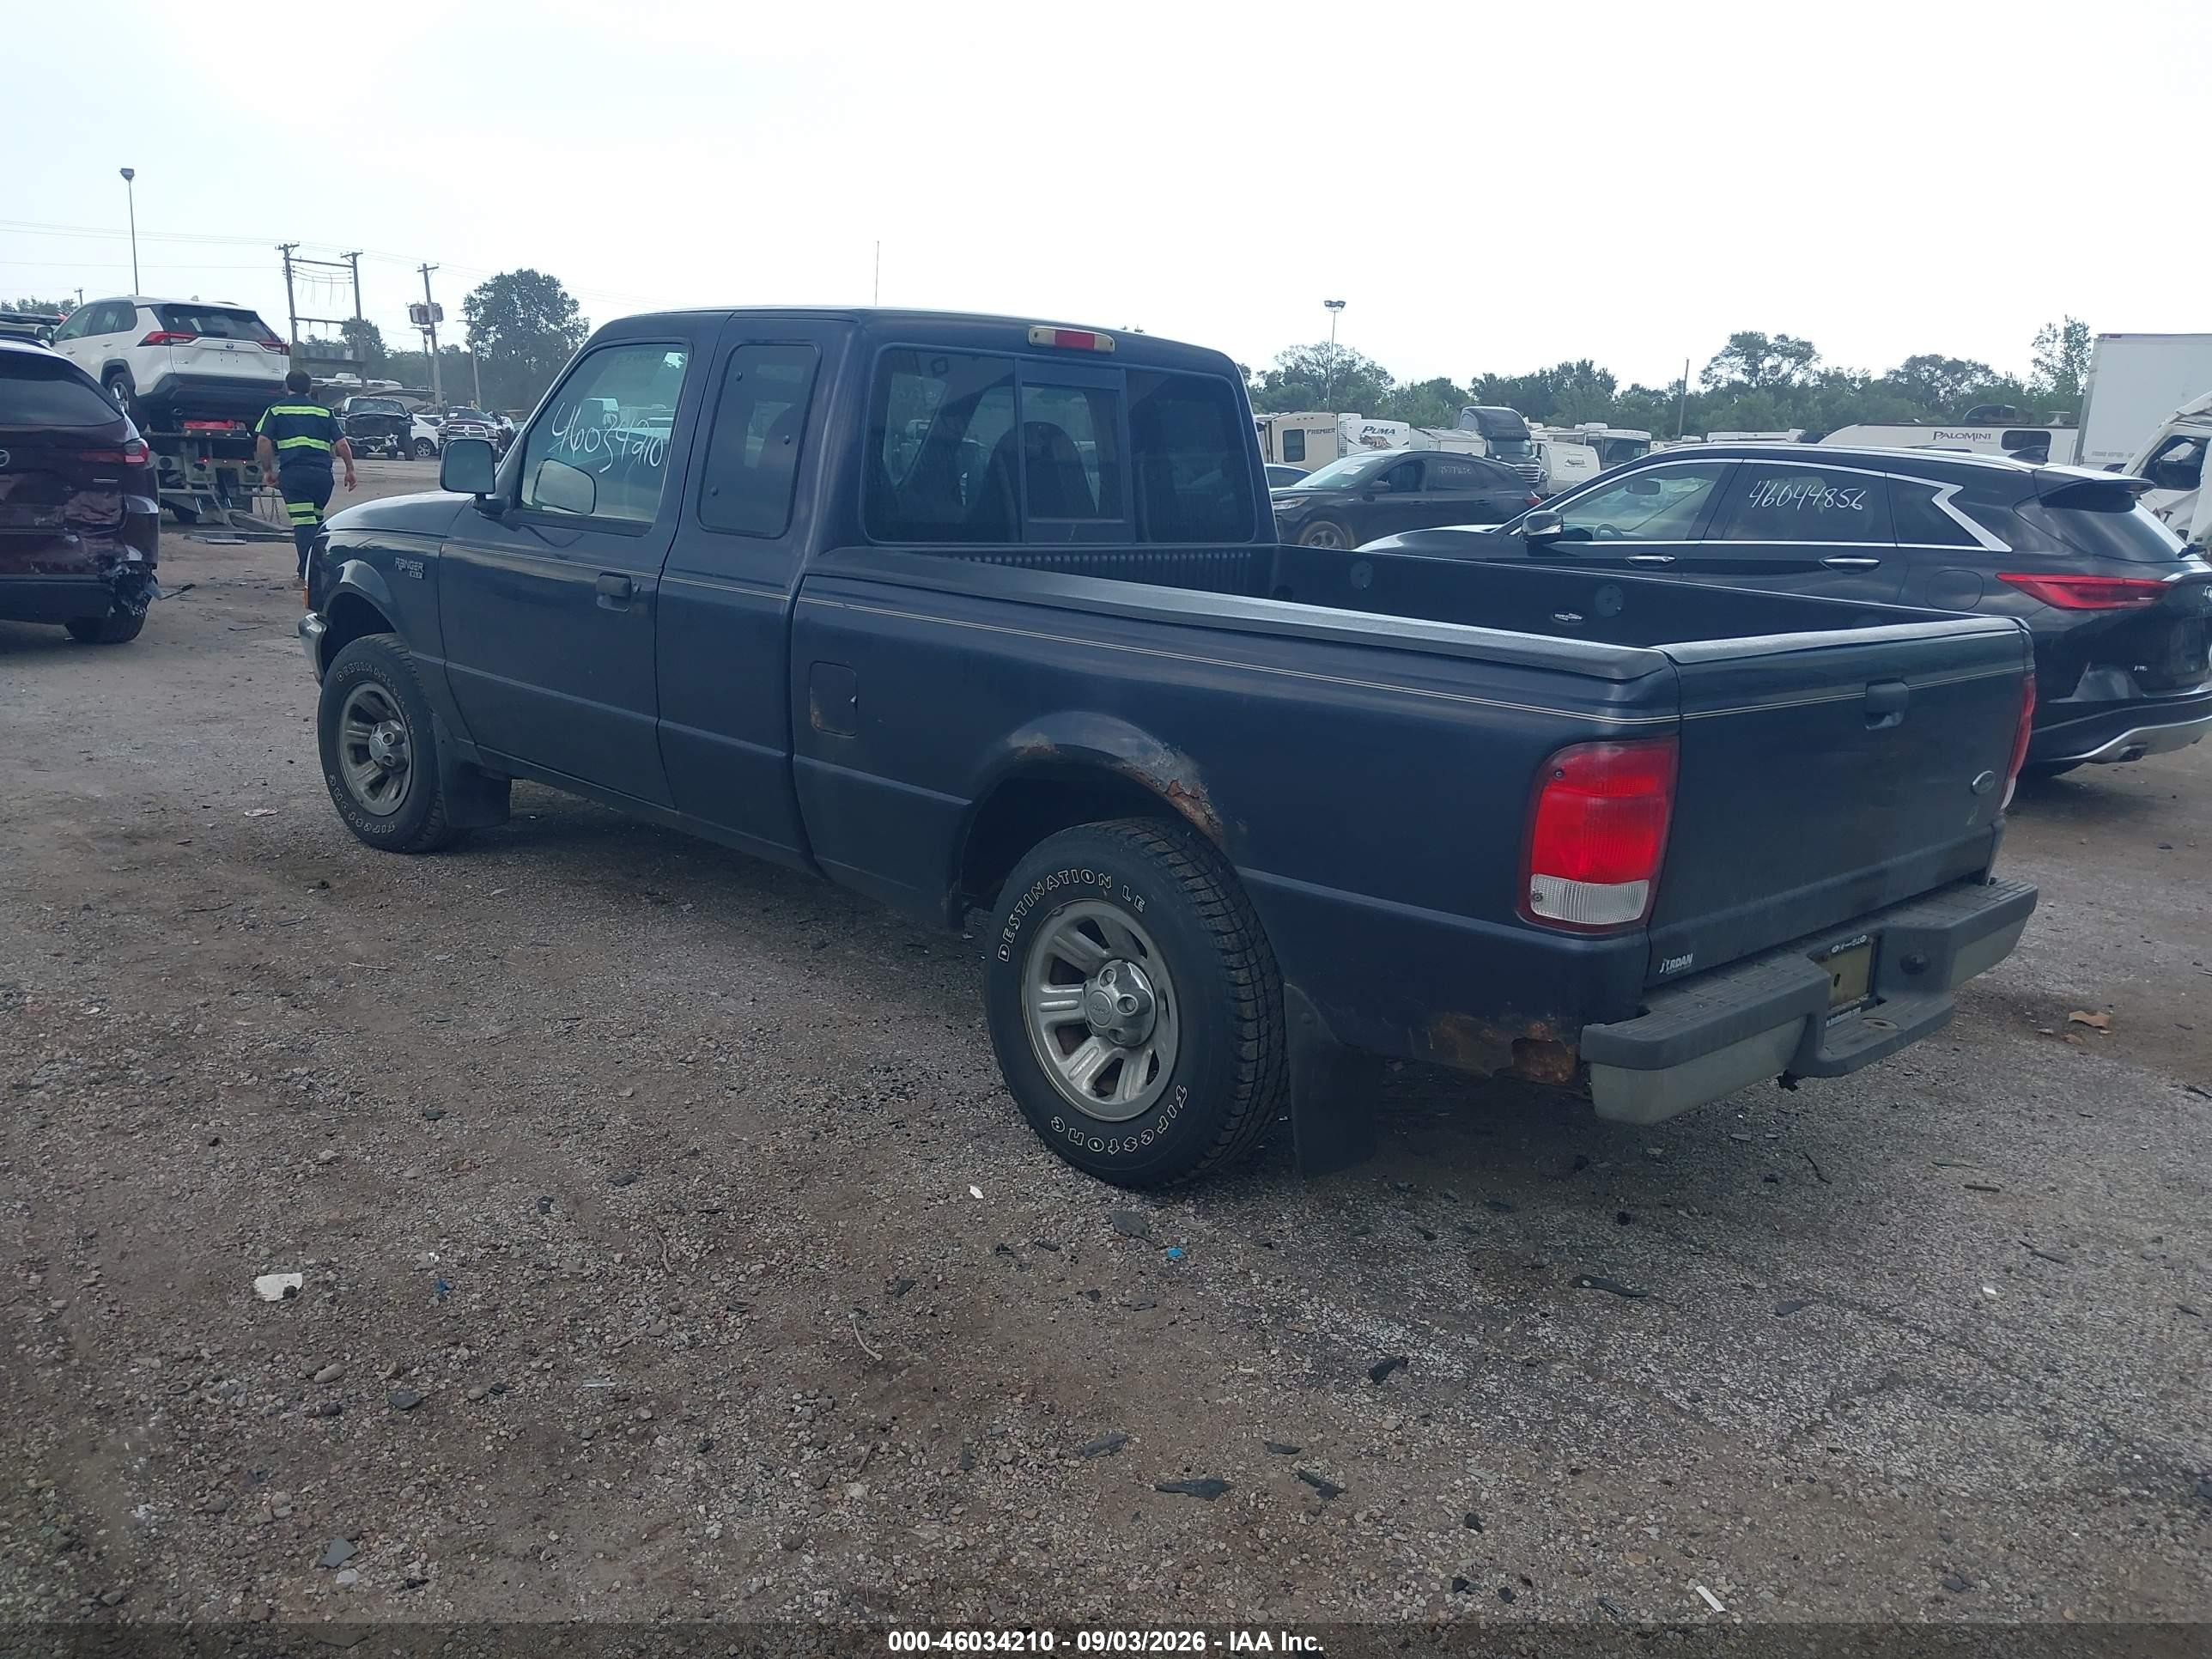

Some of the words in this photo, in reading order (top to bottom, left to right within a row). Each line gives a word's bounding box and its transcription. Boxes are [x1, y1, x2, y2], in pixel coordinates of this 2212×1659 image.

[1361, 426, 1395, 435] PUMA
[1931, 431, 1992, 441] PALOMINI
[1749, 480, 1867, 511] 46044856
[395, 556, 425, 572] RANGER
[997, 868, 1113, 963] DESTINATION
[1121, 885, 1146, 913] LE
[1050, 1085, 1188, 1155] Firestone
